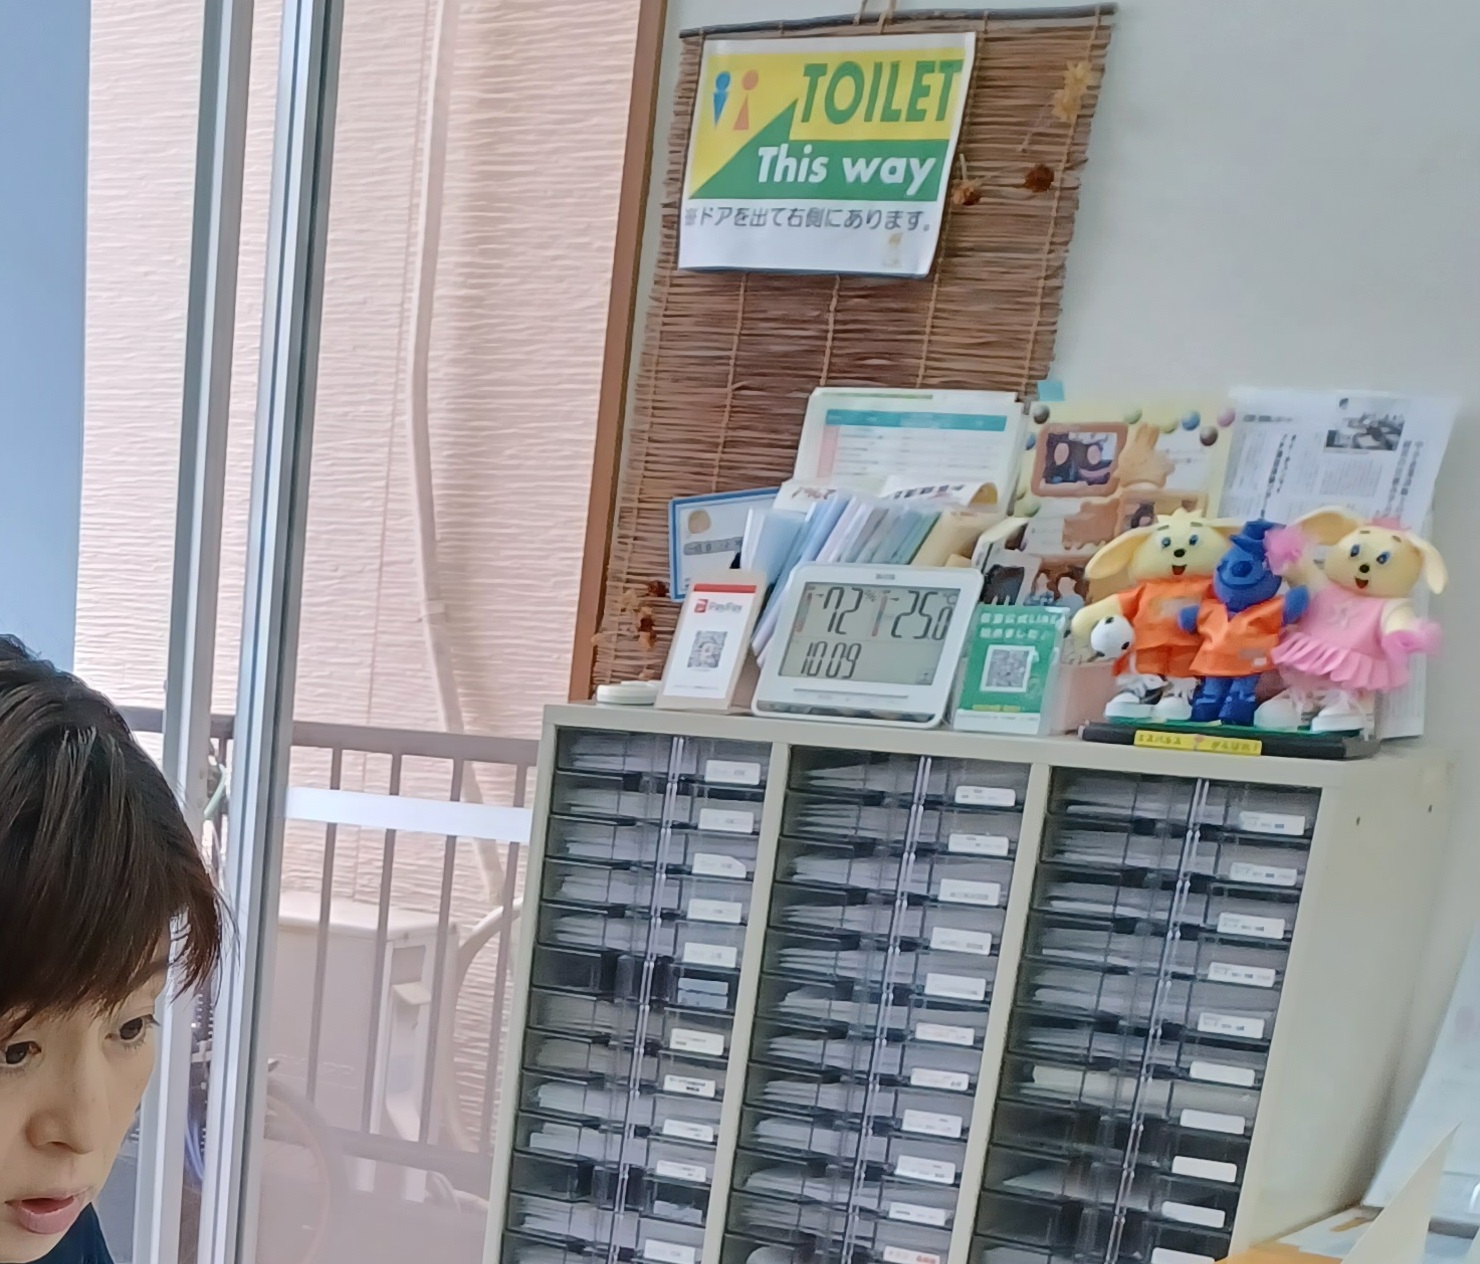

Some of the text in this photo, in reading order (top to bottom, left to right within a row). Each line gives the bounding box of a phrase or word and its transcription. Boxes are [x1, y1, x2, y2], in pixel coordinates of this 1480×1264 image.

[801, 59, 963, 126] TOILET
[758, 144, 937, 197] This way
[822, 586, 864, 635] 72
